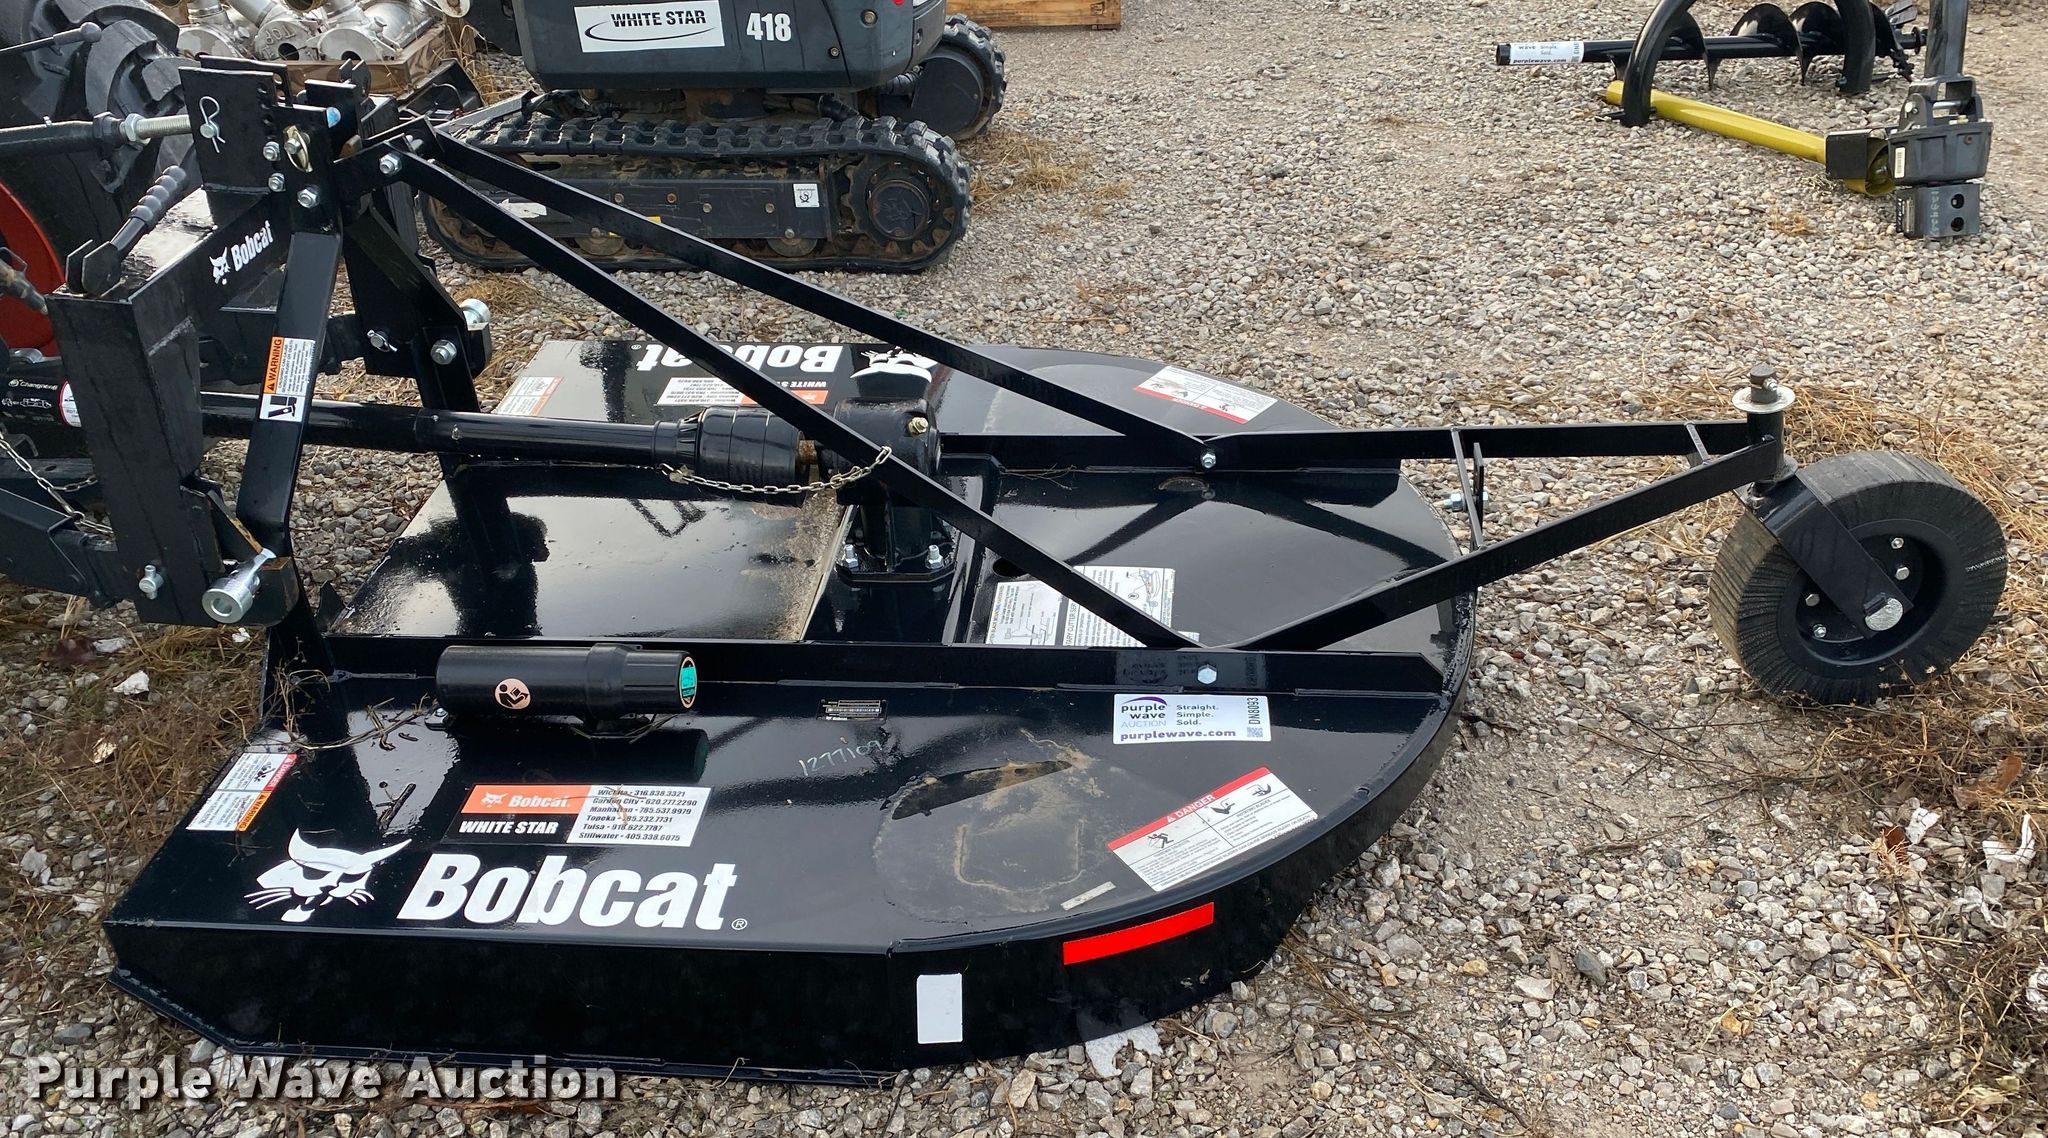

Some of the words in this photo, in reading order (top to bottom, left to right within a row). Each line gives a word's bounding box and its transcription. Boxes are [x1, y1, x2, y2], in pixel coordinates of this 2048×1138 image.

[610, 12, 662, 28] WHITE
[665, 10, 707, 26] STAR
[746, 12, 792, 42] 418
[231, 220, 274, 272] Bobcat
[268, 339, 281, 381] WARNING
[636, 344, 844, 373] Bobat
[1121, 703, 1166, 713] purple
[1246, 697, 1261, 725] DN8093
[1120, 720, 1167, 729] AUCTION
[1120, 731, 1236, 742] purplewave.com
[508, 795, 568, 808] Bobcat
[1175, 795, 1216, 817] DANGER
[459, 821, 511, 833] WHITE
[514, 821, 559, 834] STAR
[586, 815, 615, 823] Topeka
[622, 815, 673, 823] 85.232.7731
[396, 853, 738, 931] Bobcat
